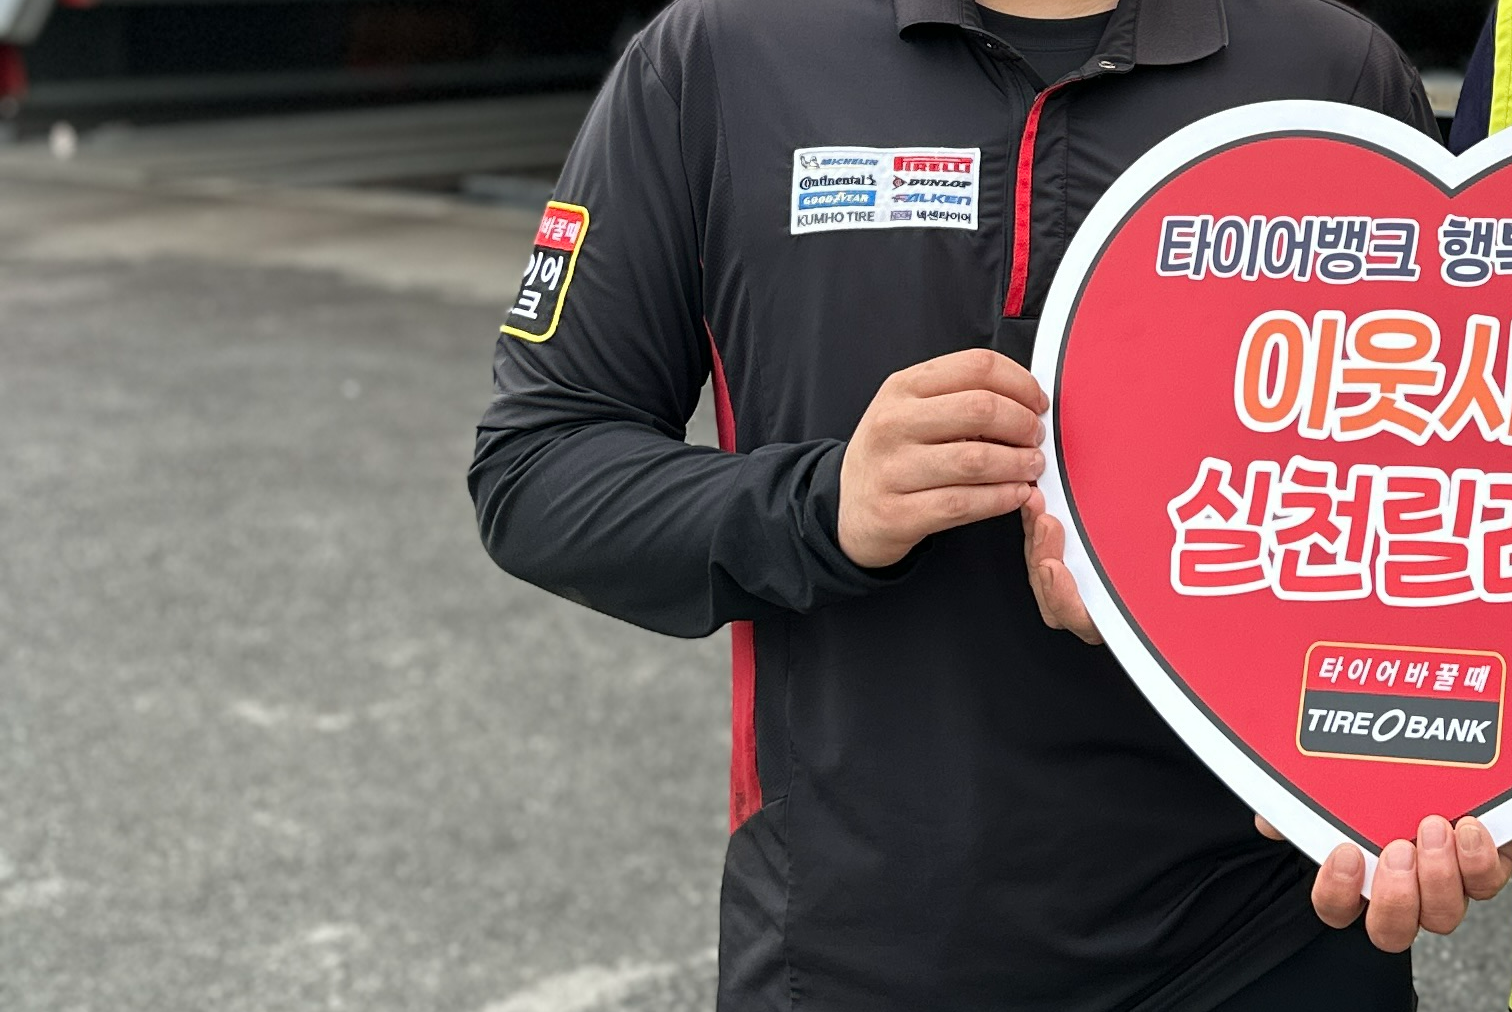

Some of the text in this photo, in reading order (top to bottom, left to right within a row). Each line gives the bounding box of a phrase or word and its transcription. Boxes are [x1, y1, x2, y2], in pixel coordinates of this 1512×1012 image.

[820, 157, 879, 166] MICHELIN
[893, 156, 974, 174] PIRELLI
[800, 174, 867, 190] Continental
[907, 178, 972, 189] DUNLOP
[803, 192, 869, 206] GOODYEAR
[892, 193, 972, 206] FALKEN
[797, 211, 845, 227] KUMHO
[846, 211, 875, 223] TIRE
[916, 210, 972, 225] 넥센타이어
[1157, 215, 1419, 283] 타이어뱅크
